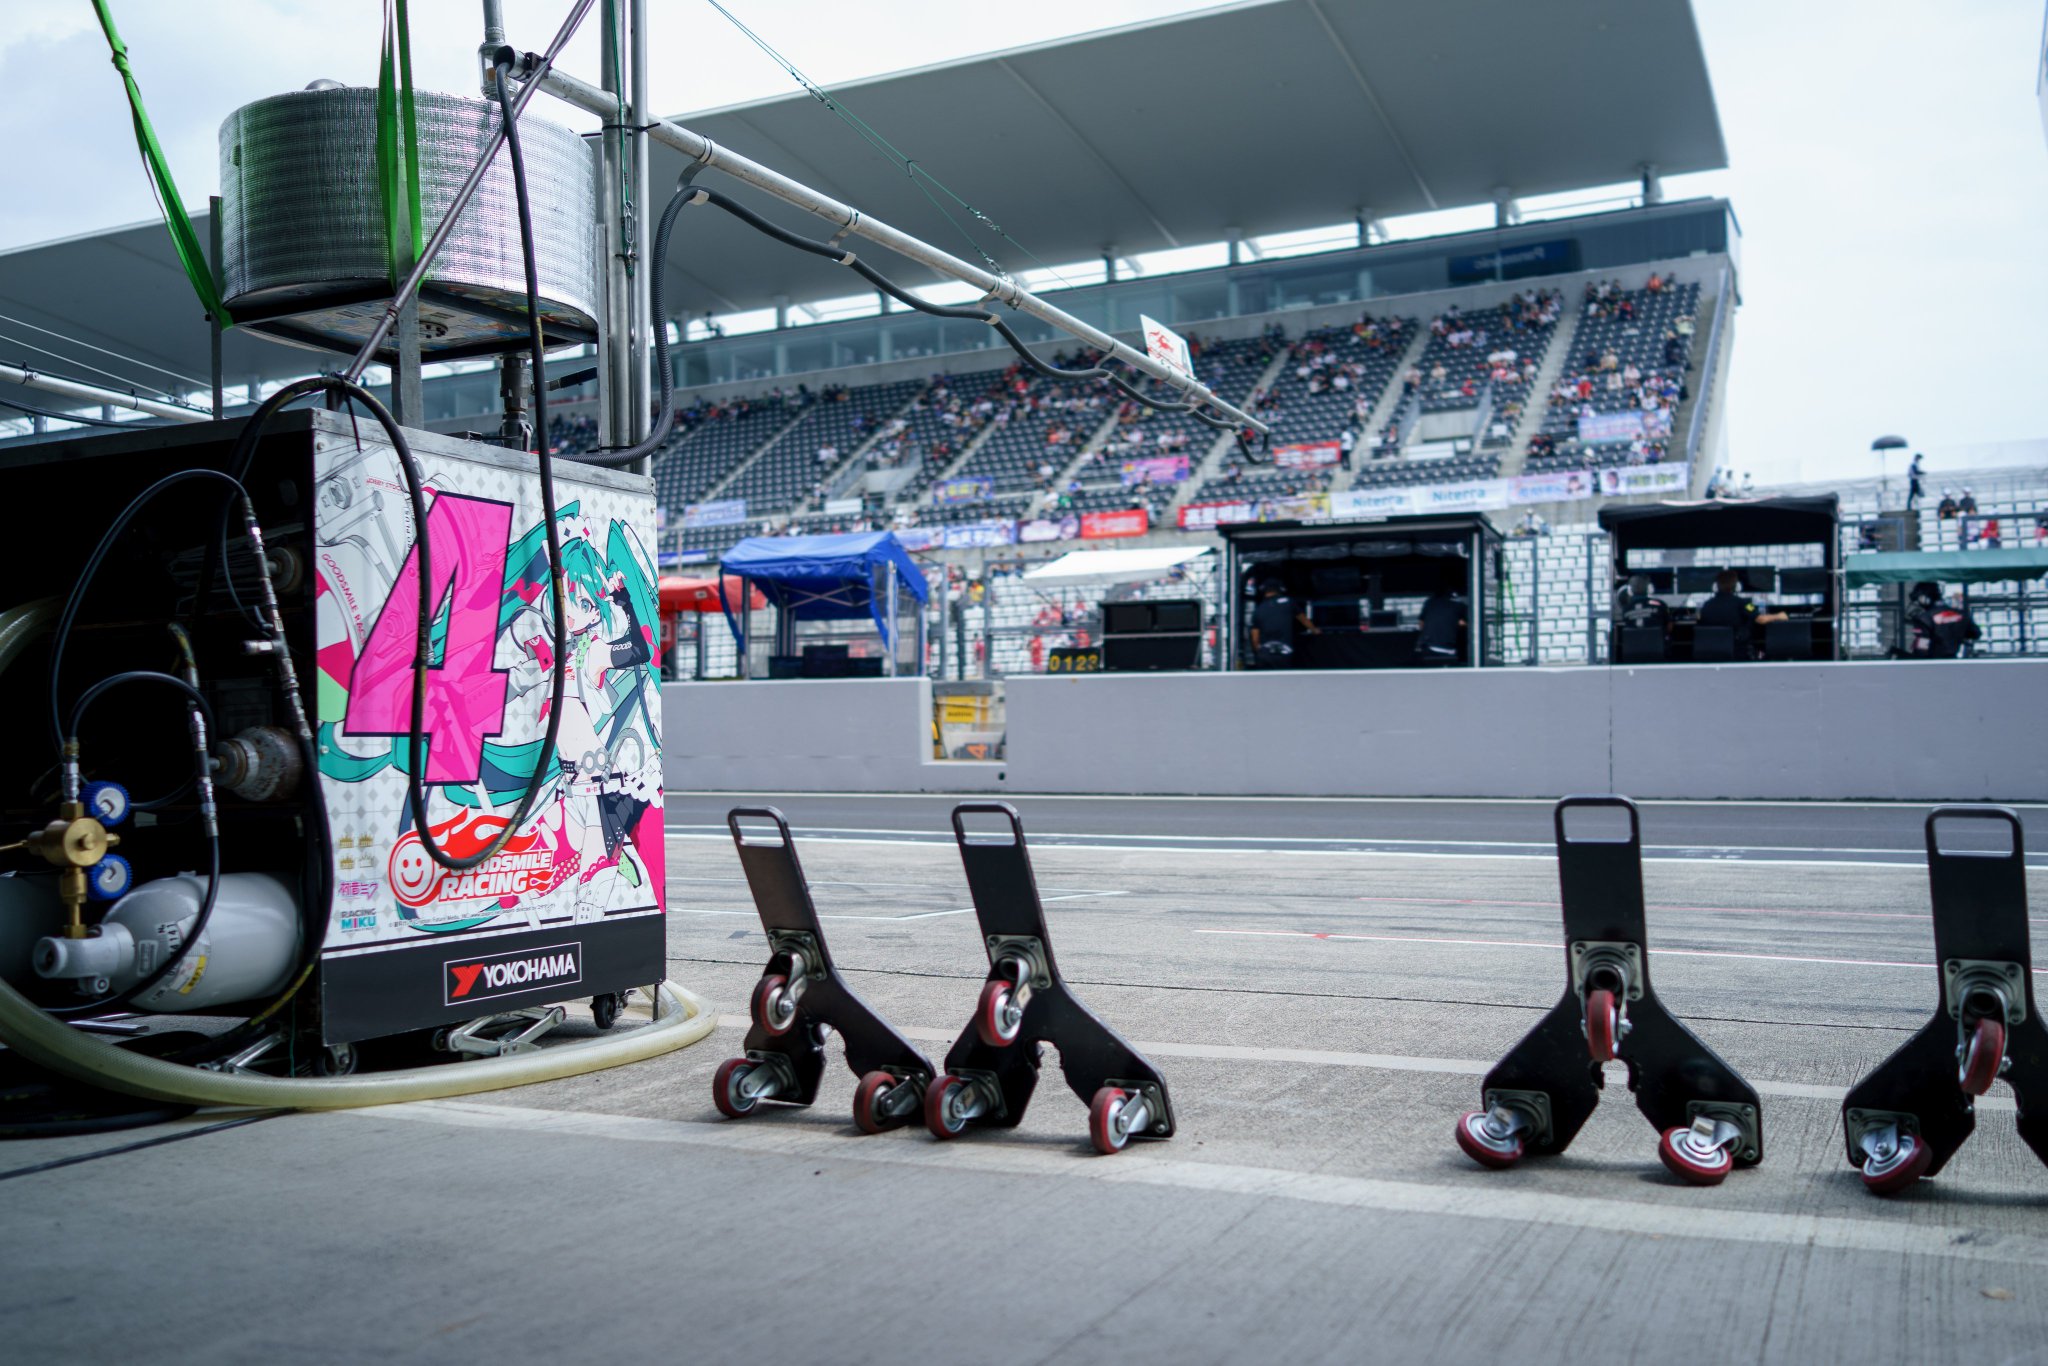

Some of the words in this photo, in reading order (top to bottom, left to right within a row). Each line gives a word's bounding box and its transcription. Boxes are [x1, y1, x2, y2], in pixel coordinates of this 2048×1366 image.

[342, 490, 516, 786] 4
[439, 870, 529, 901] RACING
[341, 908, 376, 919] RACING
[341, 915, 377, 930] MIKU
[483, 952, 577, 989] YOKOHAMA
